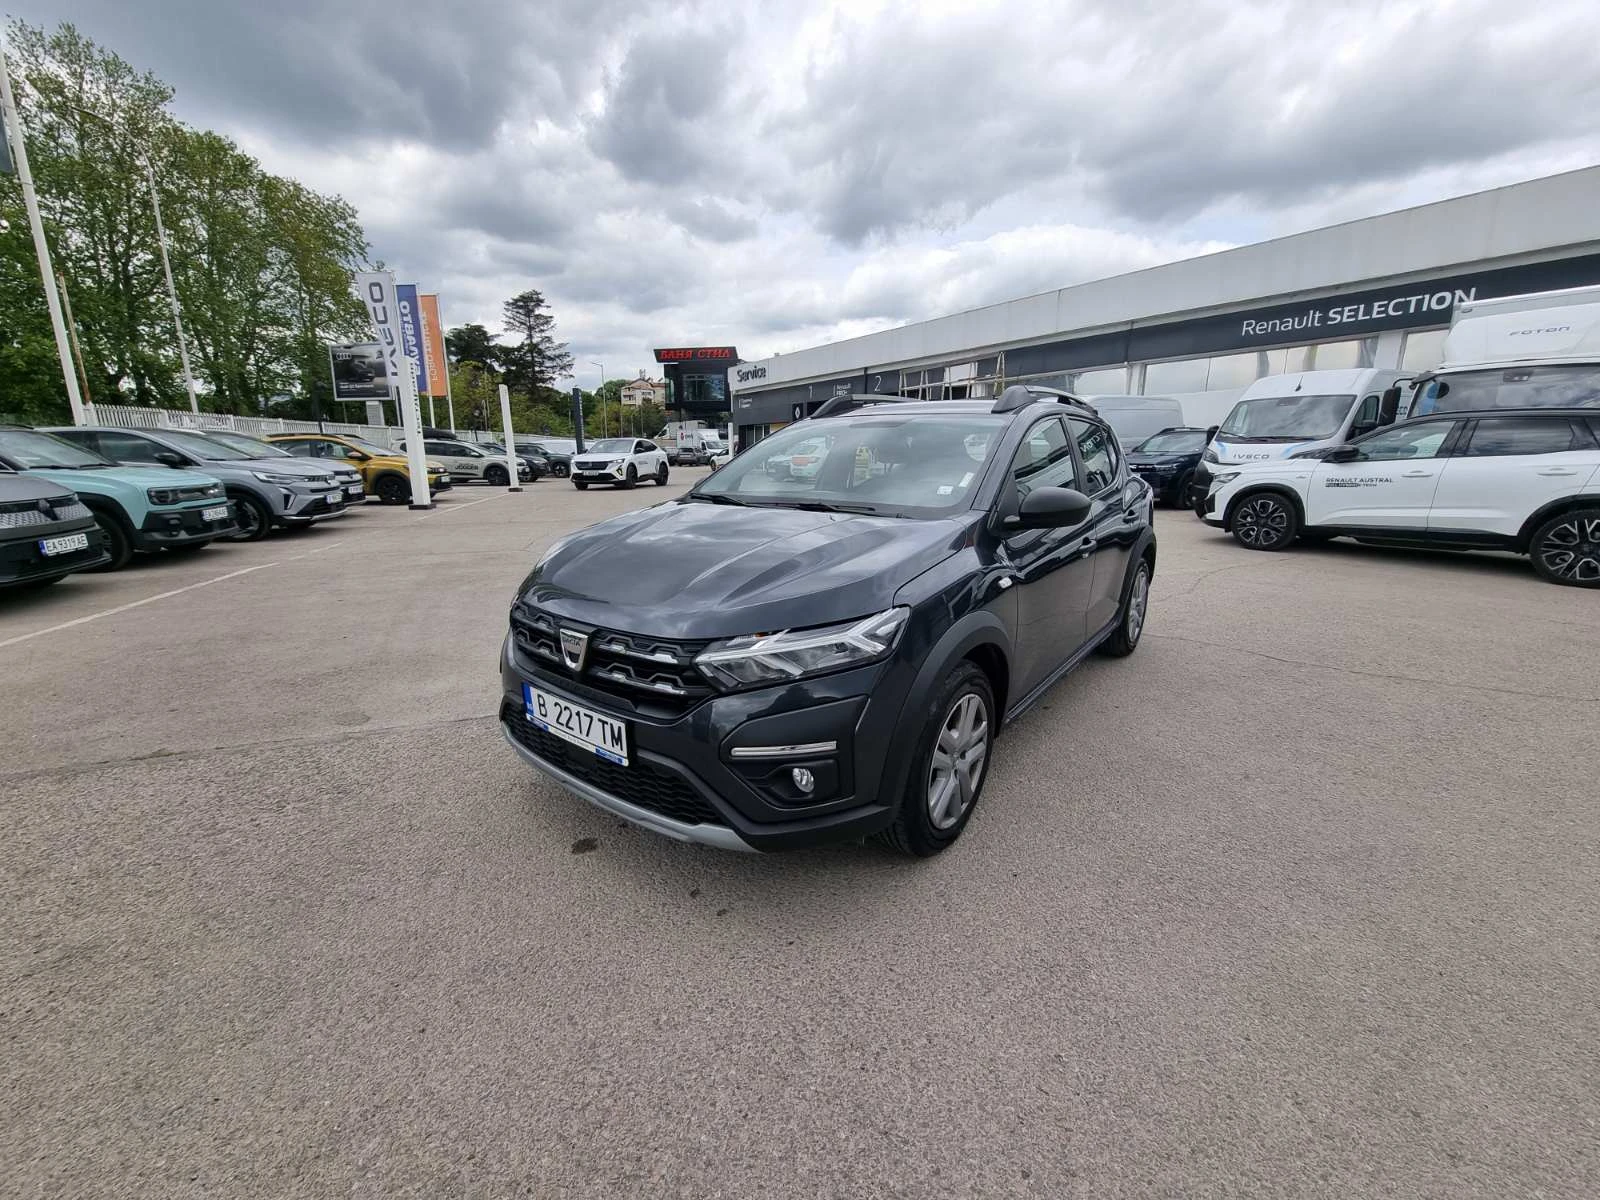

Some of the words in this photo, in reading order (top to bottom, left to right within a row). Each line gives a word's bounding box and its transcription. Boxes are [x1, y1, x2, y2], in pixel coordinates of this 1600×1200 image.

[1241, 309, 1323, 337] Renault
[1327, 287, 1477, 325] SELECTION
[736, 365, 767, 383] Service
[874, 375, 882, 392] 2
[537, 694, 548, 718] B
[554, 702, 594, 737] 2217
[598, 717, 623, 751] TM
